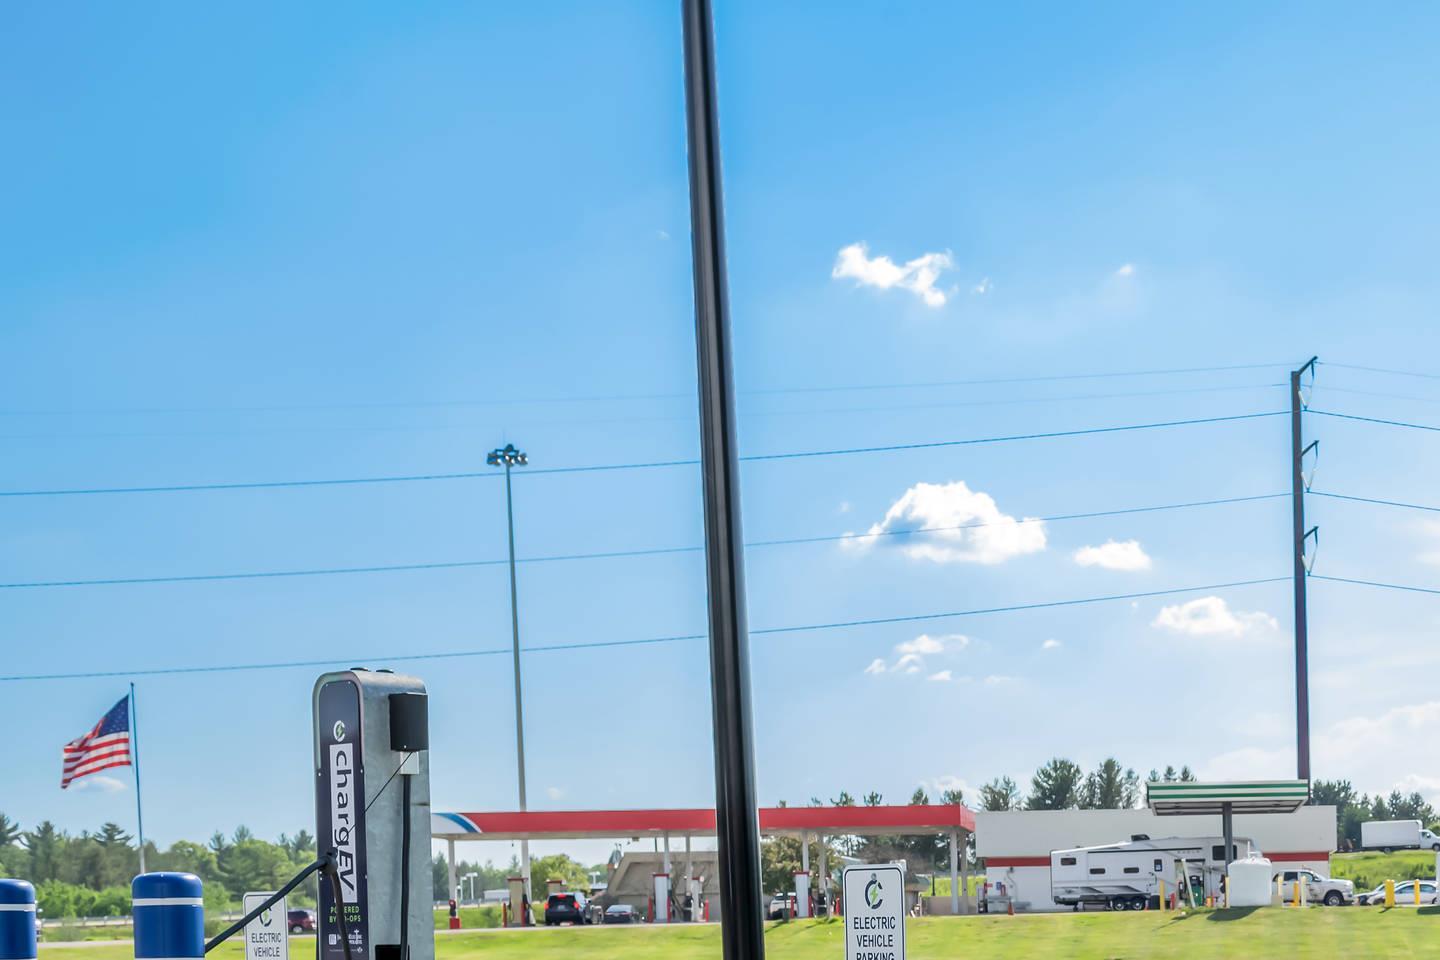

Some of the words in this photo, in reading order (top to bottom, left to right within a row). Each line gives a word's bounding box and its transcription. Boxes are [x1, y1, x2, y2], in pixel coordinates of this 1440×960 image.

[330, 905, 360, 914] PERED
[853, 916, 896, 930] ELECTRIC
[251, 932, 282, 943] ELECTRIC
[856, 934, 894, 948] VEHICLE
[253, 947, 280, 957] VEHICLE
